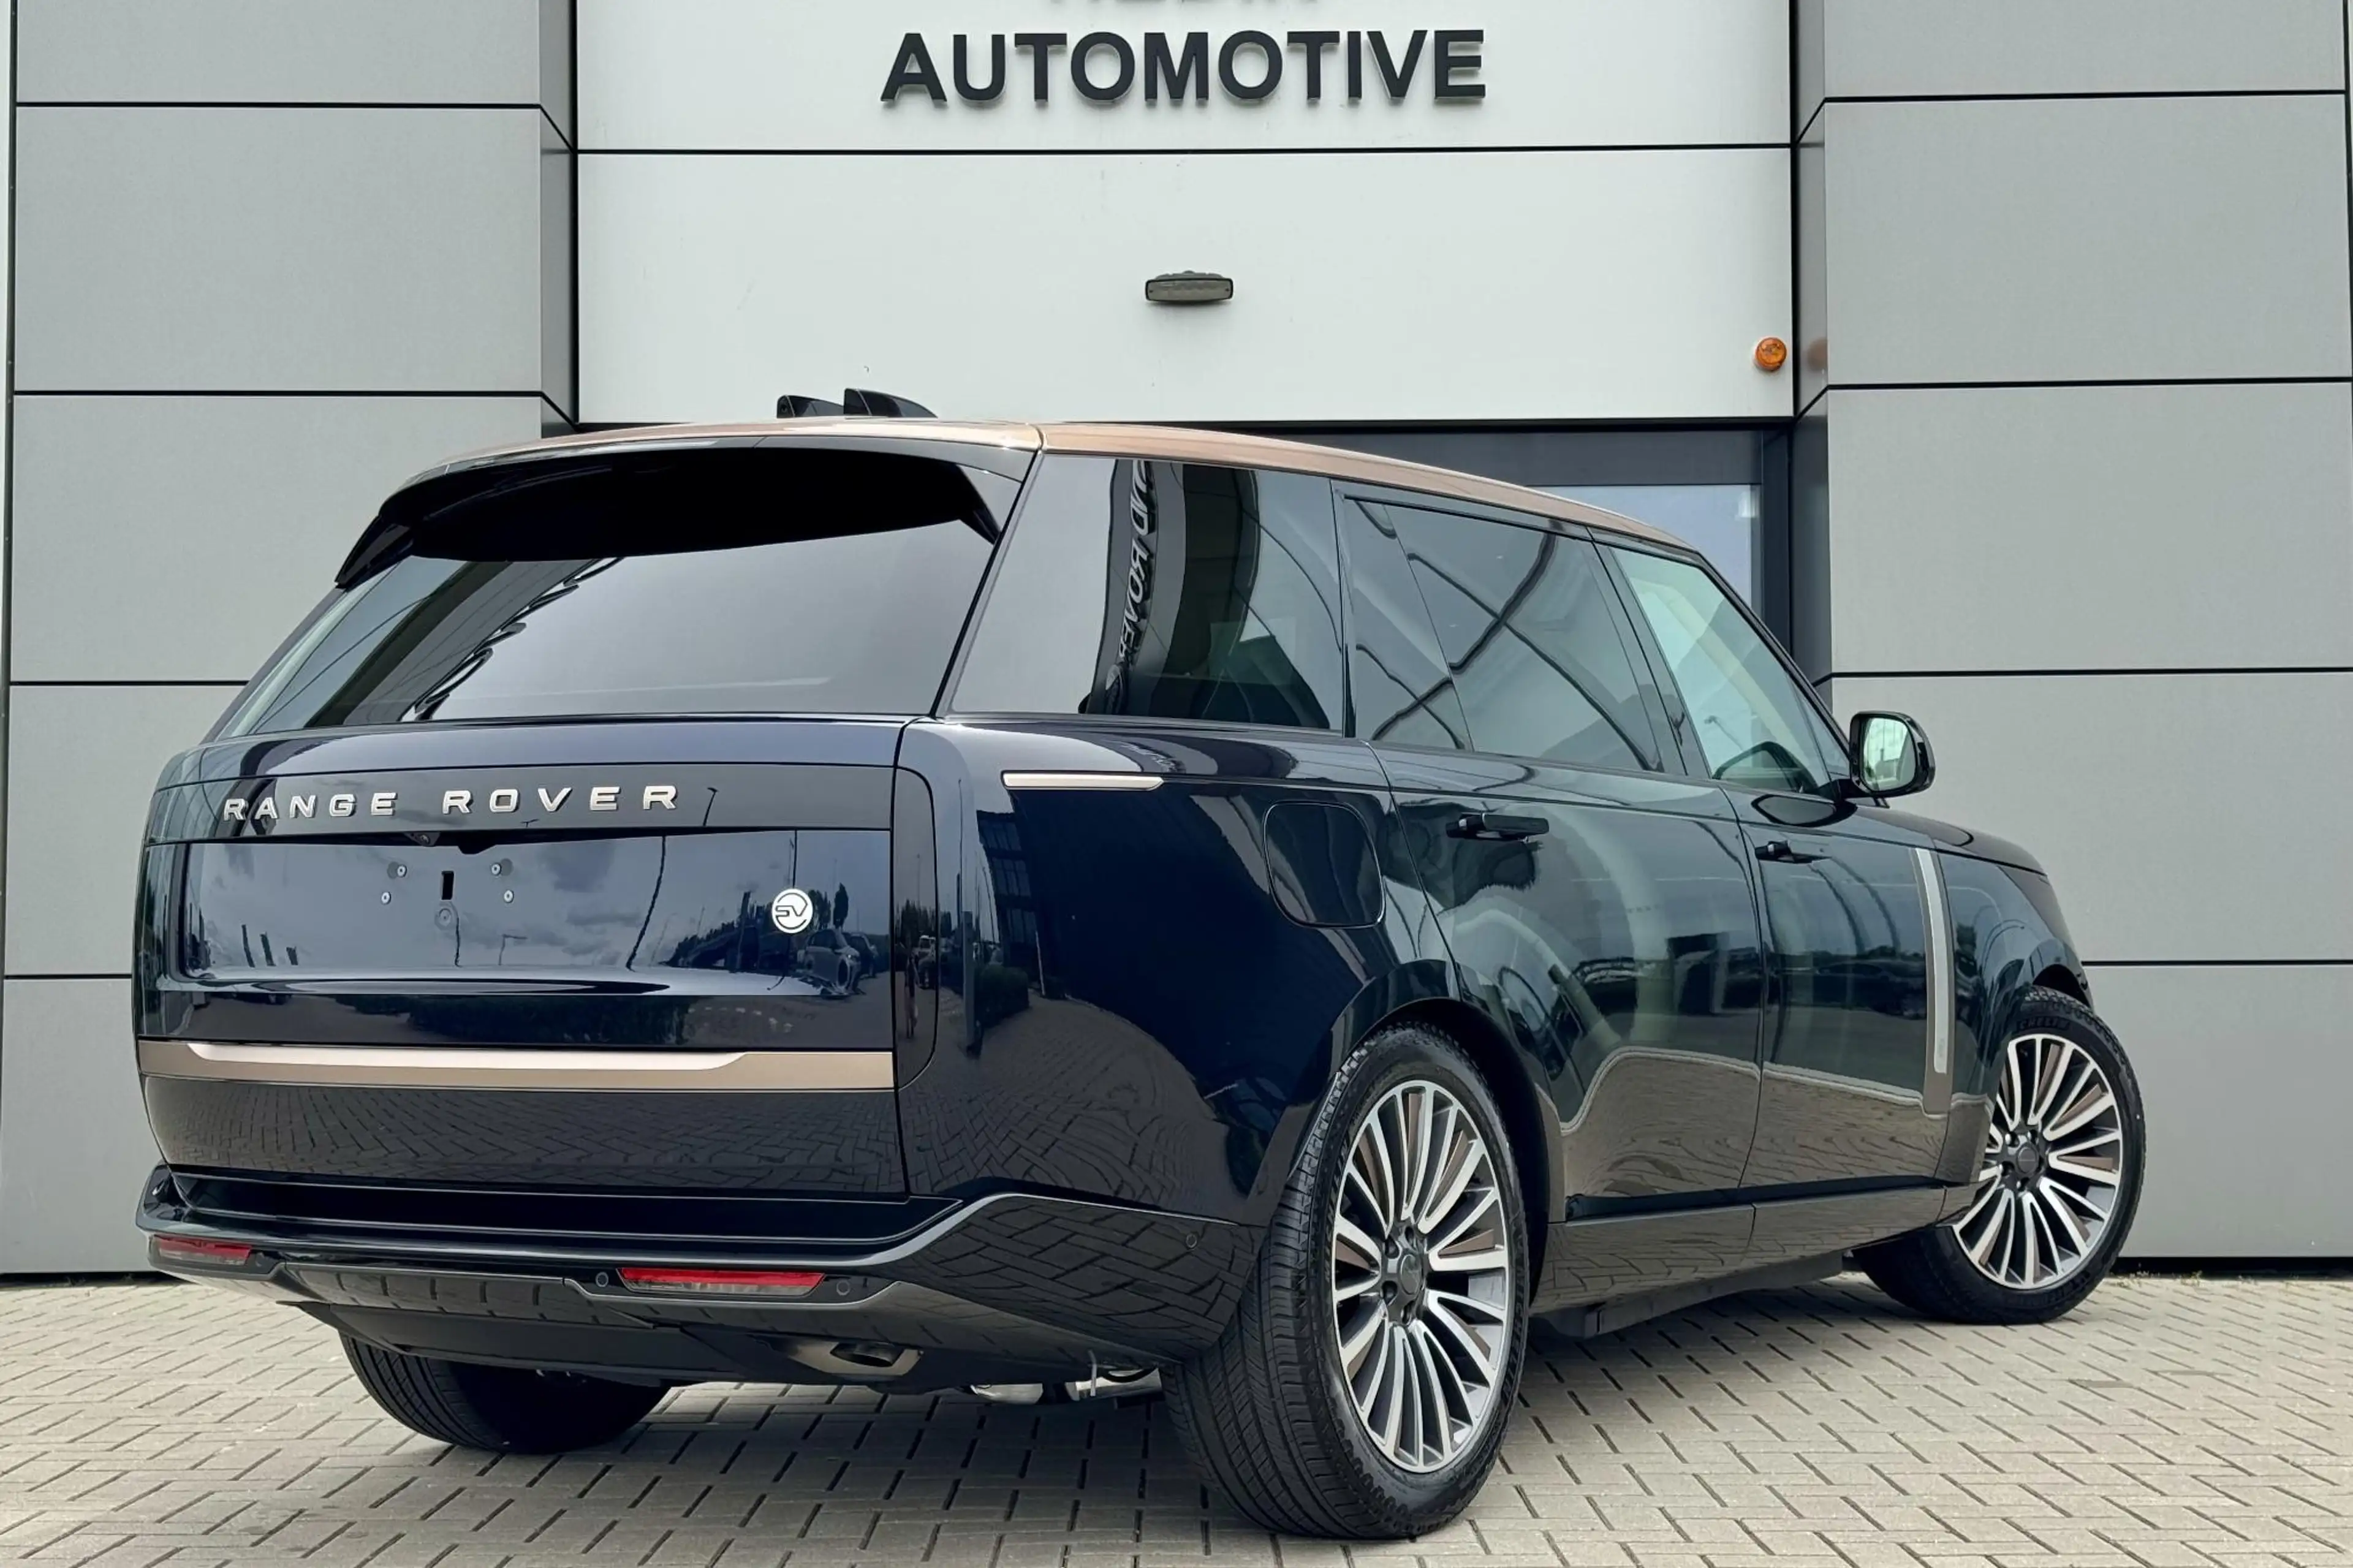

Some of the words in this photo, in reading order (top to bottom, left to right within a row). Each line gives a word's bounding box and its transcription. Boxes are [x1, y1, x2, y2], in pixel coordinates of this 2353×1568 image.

[881, 29, 1486, 102] AUTOMOTIVE
[224, 792, 398, 820] RANGE
[442, 785, 677, 814] ROVER
